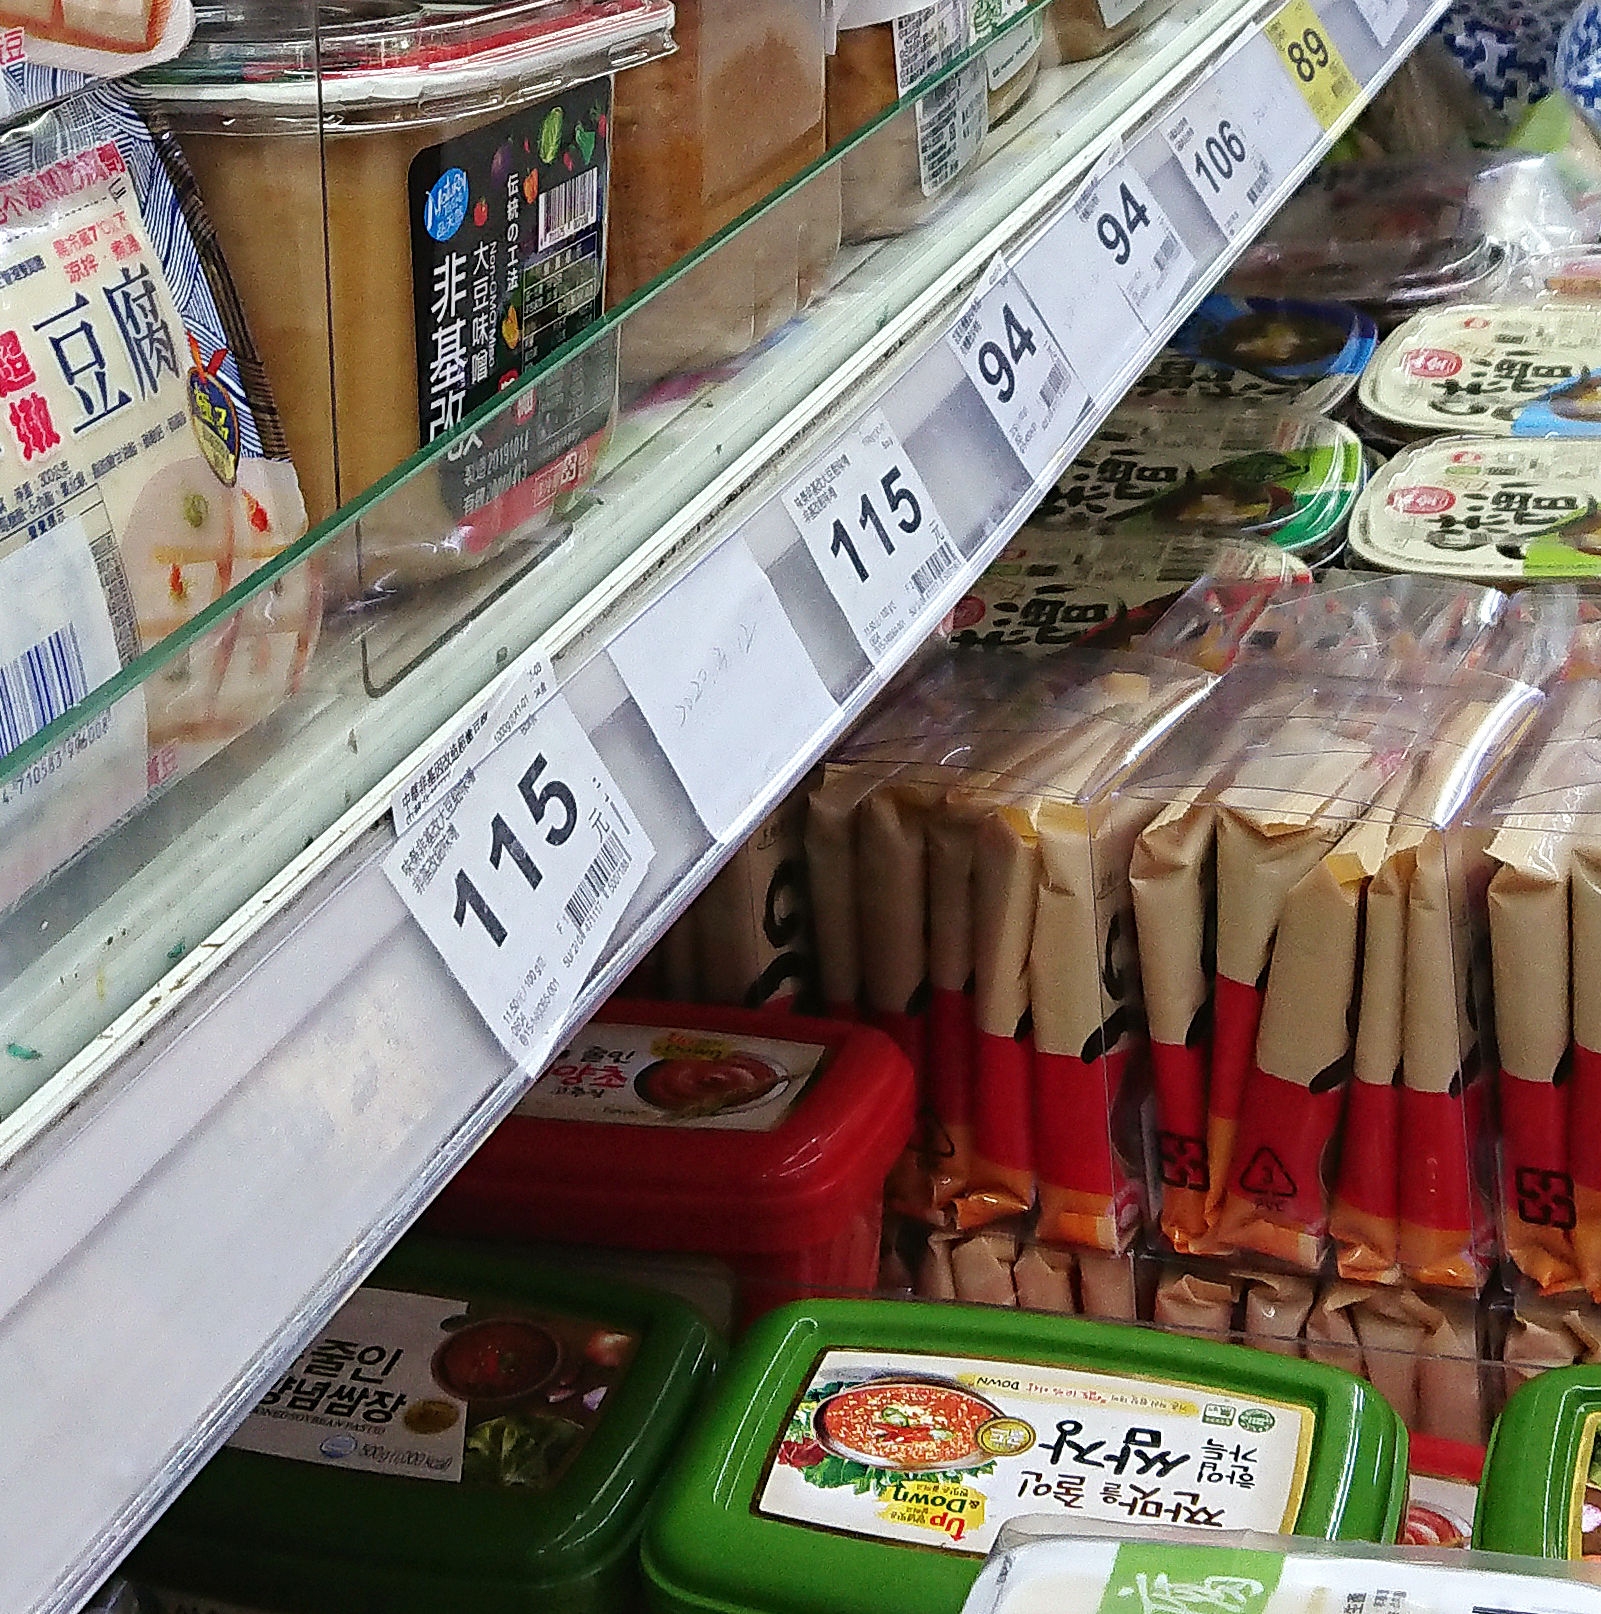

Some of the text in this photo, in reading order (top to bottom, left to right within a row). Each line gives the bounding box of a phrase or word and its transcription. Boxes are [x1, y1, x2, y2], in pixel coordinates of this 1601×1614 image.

[1288, 28, 1331, 84] 89
[1194, 119, 1247, 194] 106
[1097, 180, 1148, 267] 94
[470, 241, 490, 385] 大豆味噌
[32, 263, 182, 436] 豆腐
[977, 301, 1036, 405] 94
[829, 464, 923, 585] 115
[451, 751, 580, 948] 115
[588, 810, 611, 848] 元
[307, 1336, 405, 1379] 줄인
[1034, 1421, 1193, 1480] 쌈장
[890, 1486, 968, 1516] Down
[1015, 1469, 1087, 1509] 줄인
[927, 1510, 967, 1544] Up
